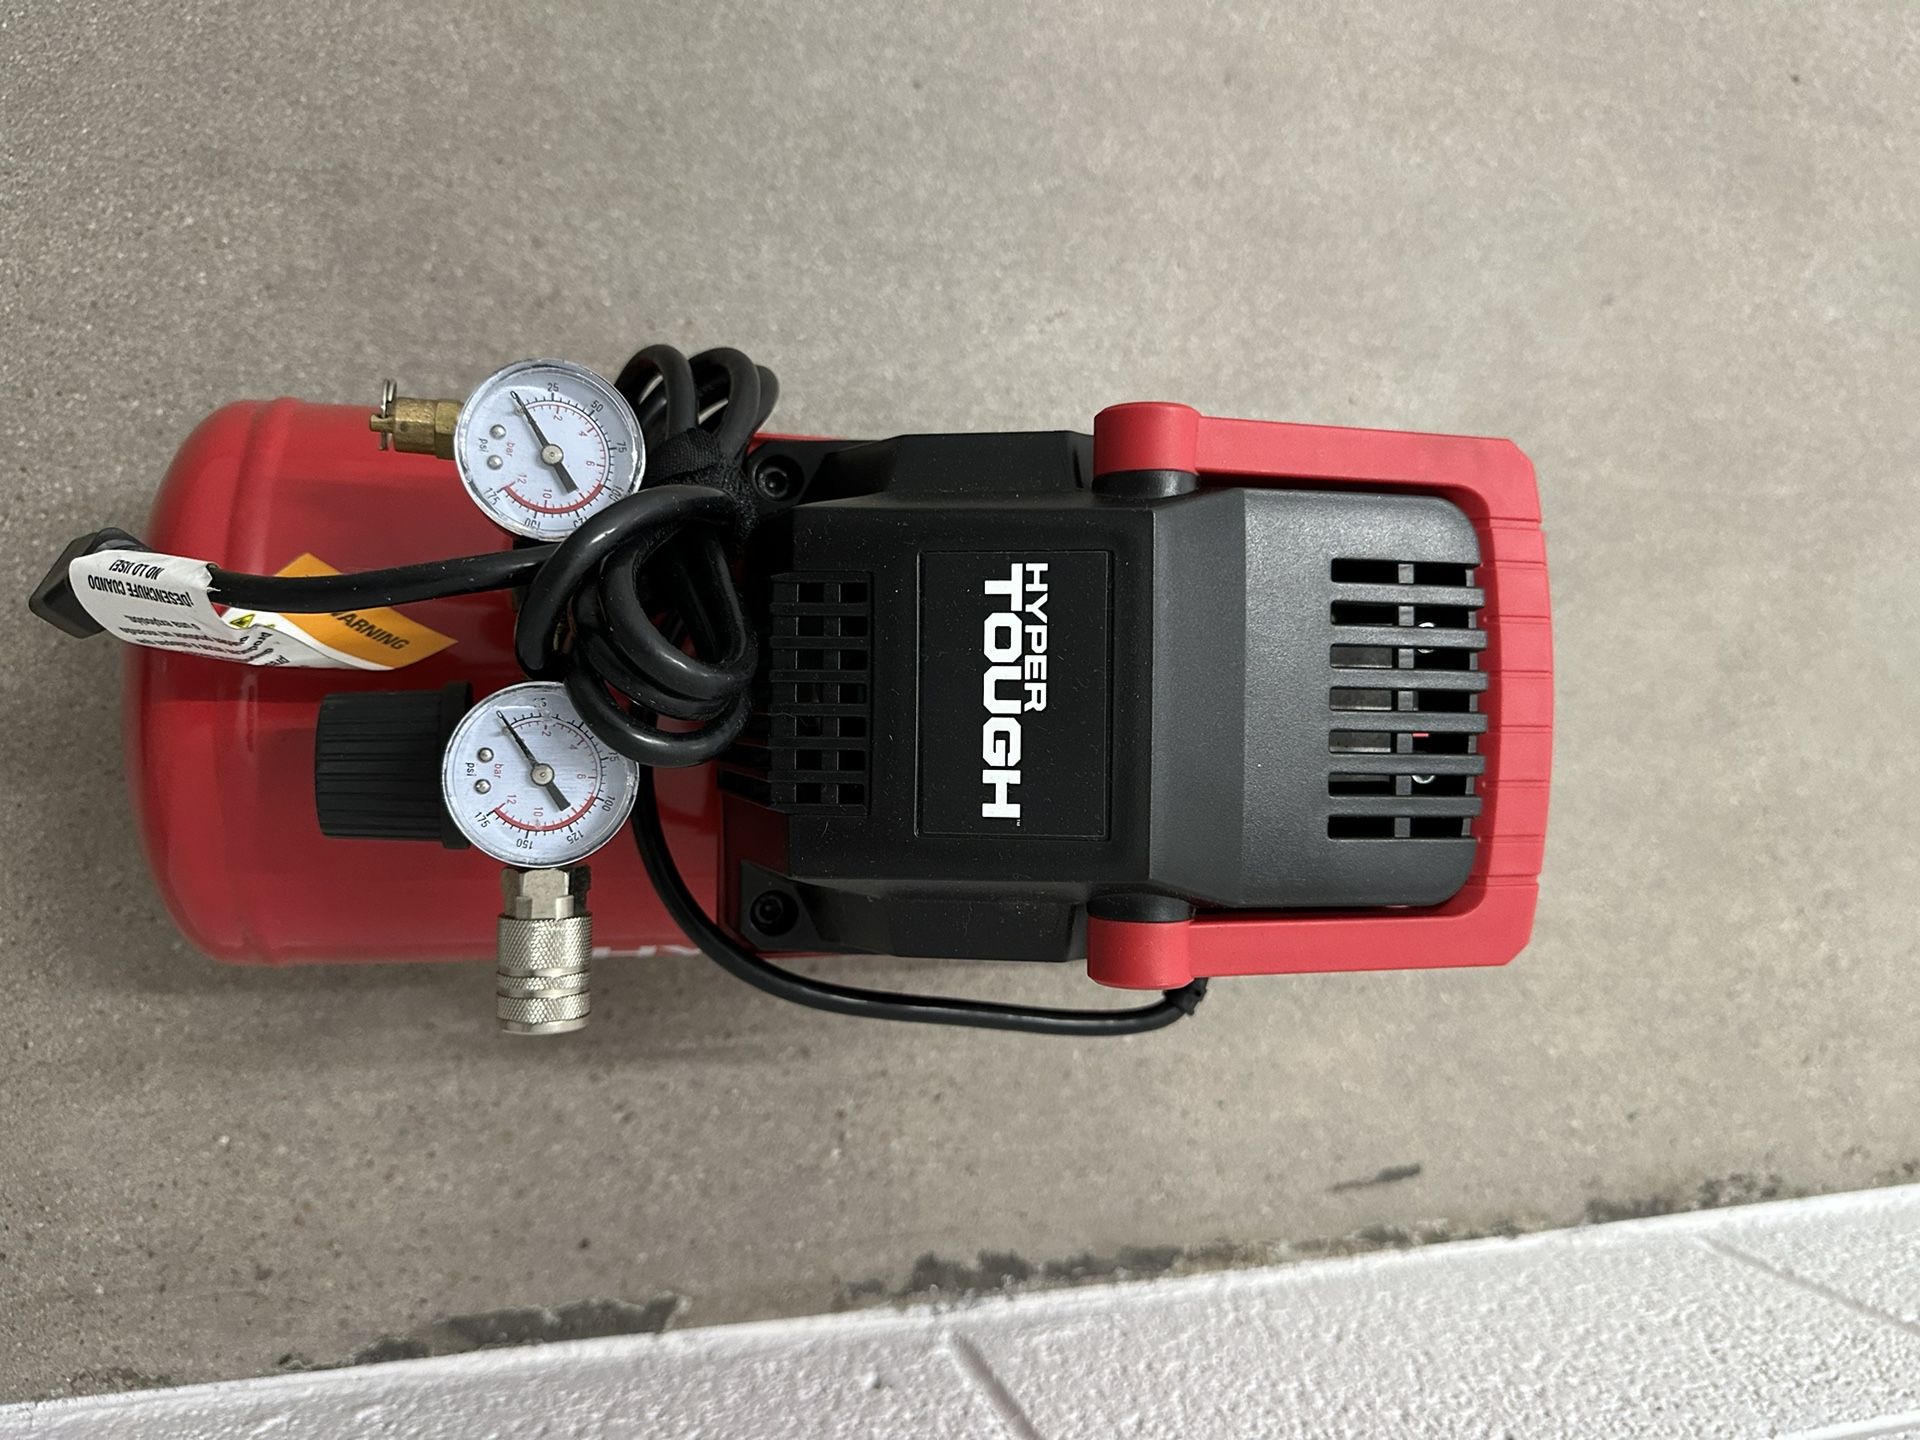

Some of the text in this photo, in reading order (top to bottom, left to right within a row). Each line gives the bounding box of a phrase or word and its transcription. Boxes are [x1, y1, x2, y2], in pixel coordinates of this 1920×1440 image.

[547, 382, 560, 392] 25
[590, 399, 604, 412] 50
[553, 414, 563, 422] 2
[478, 437, 489, 453] psi
[505, 440, 516, 457] bar
[616, 440, 627, 454] 75
[517, 473, 528, 485] 12
[542, 488, 553, 499] 10
[132, 563, 149, 577] LO
[145, 565, 165, 580] NO
[87, 574, 126, 596] CUANDO
[1024, 563, 1049, 712] HYPER
[981, 563, 1023, 818] TOUGH
[465, 762, 477, 777] psi
[493, 763, 504, 779] bar
[506, 794, 517, 805] 12
[602, 795, 616, 812] 100
[474, 811, 491, 828] 175
[533, 807, 544, 817] 10
[516, 838, 534, 850] 150
[566, 830, 584, 845] 125
